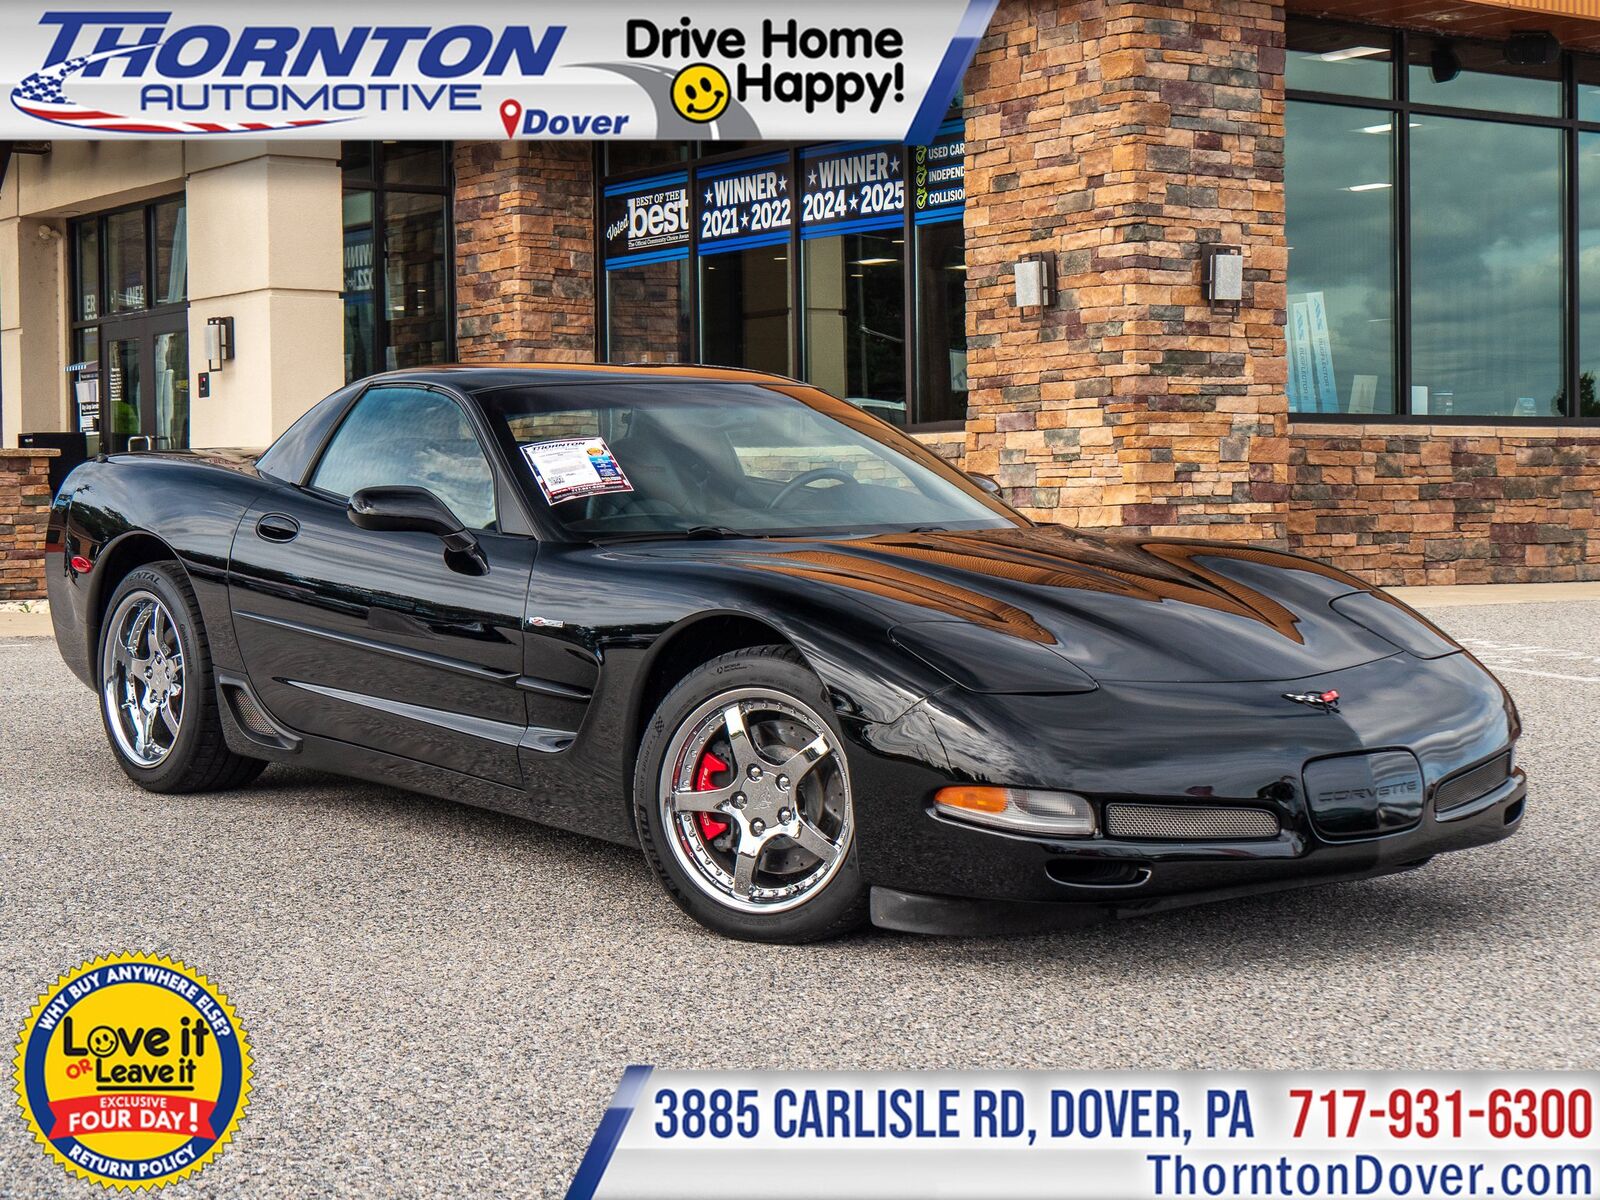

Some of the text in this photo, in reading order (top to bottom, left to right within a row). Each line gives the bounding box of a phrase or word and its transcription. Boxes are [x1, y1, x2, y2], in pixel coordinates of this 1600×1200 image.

[928, 146, 948, 159] USED
[818, 152, 889, 189] WINNER
[635, 189, 680, 207] BEST OF THE
[714, 172, 778, 207] WINNER
[802, 181, 904, 222] 2024 2025
[606, 213, 630, 241] Voted
[627, 189, 688, 238] best
[702, 198, 791, 239] 2021 2022
[1319, 781, 1416, 801] CORVETTE
